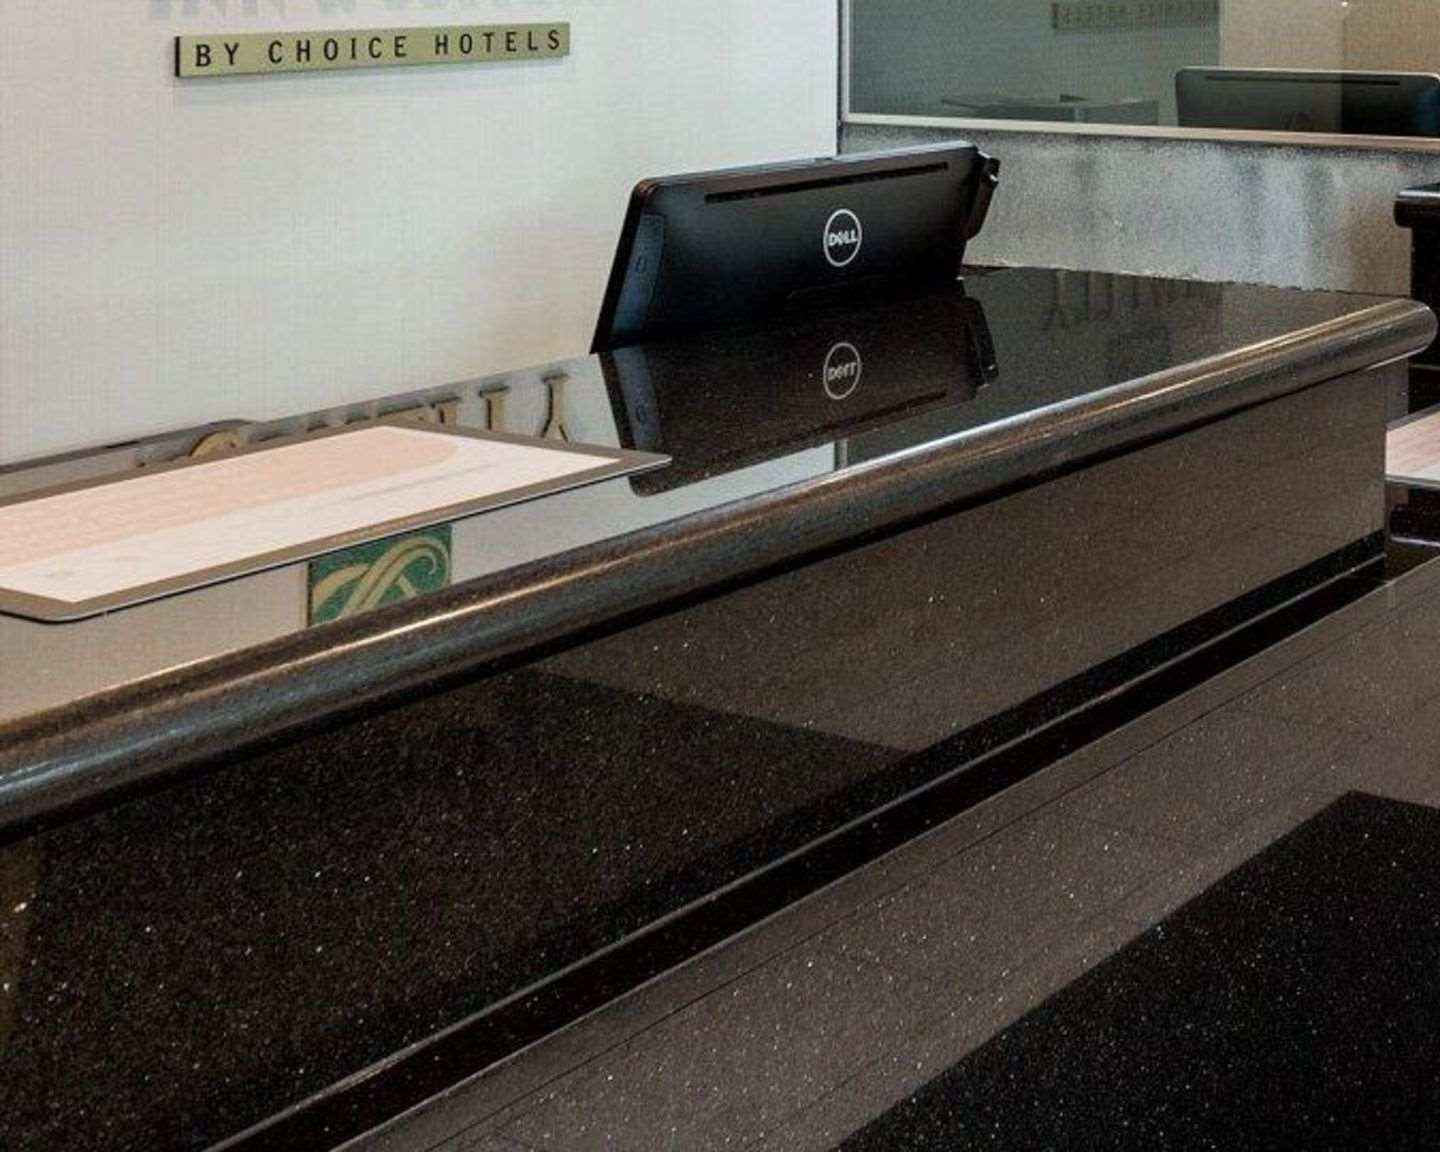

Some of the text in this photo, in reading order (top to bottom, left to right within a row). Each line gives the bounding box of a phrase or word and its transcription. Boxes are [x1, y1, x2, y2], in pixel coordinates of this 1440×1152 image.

[195, 28, 561, 67] BY CHOICE HOTELS
[828, 229, 858, 246] DELL
